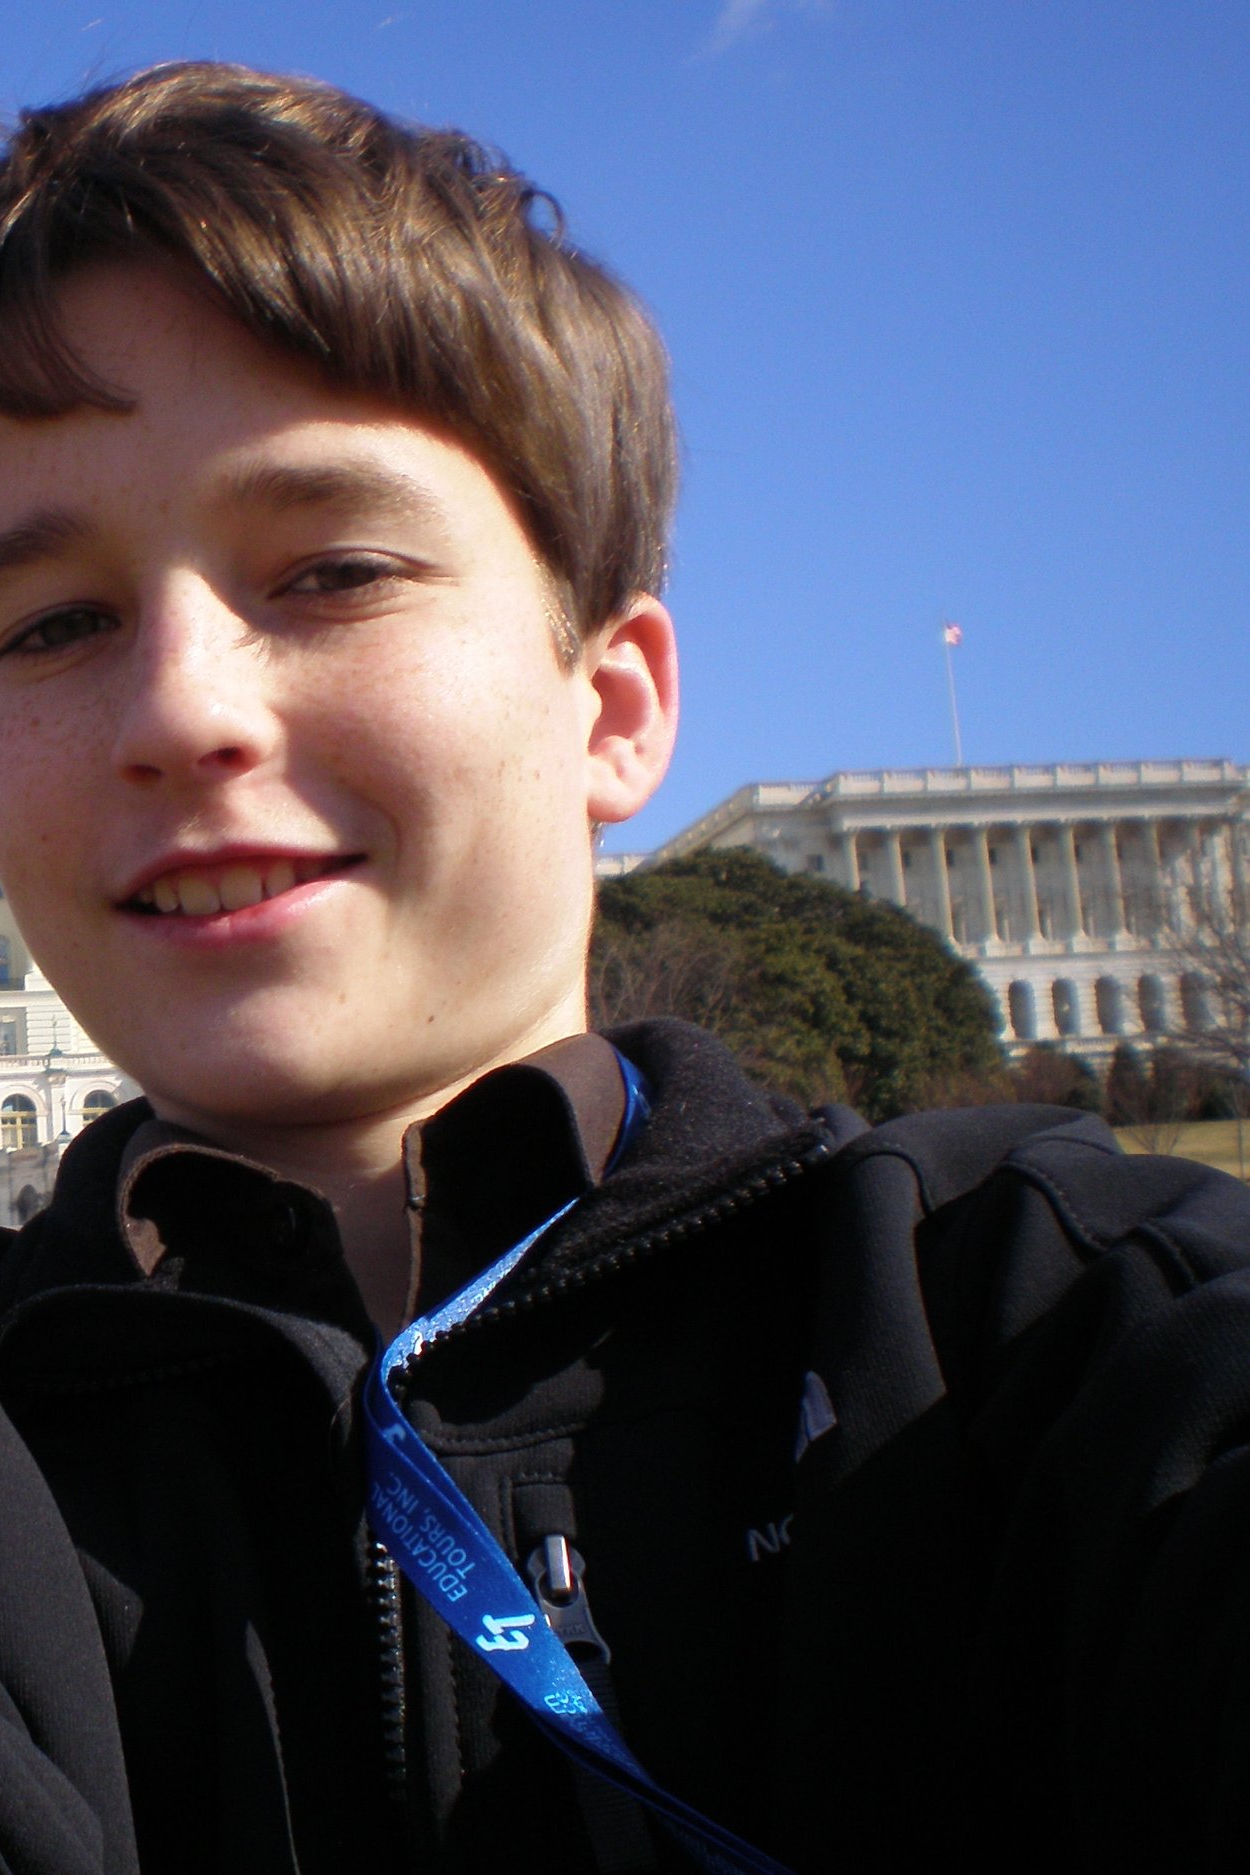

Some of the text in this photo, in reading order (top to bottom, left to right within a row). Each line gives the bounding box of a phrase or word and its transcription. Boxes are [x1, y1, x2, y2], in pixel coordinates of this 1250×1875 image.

[387, 1471, 419, 1515] INC.
[371, 1481, 469, 1602] EDUCATIONAL
[420, 1505, 476, 1580] TOURS,
